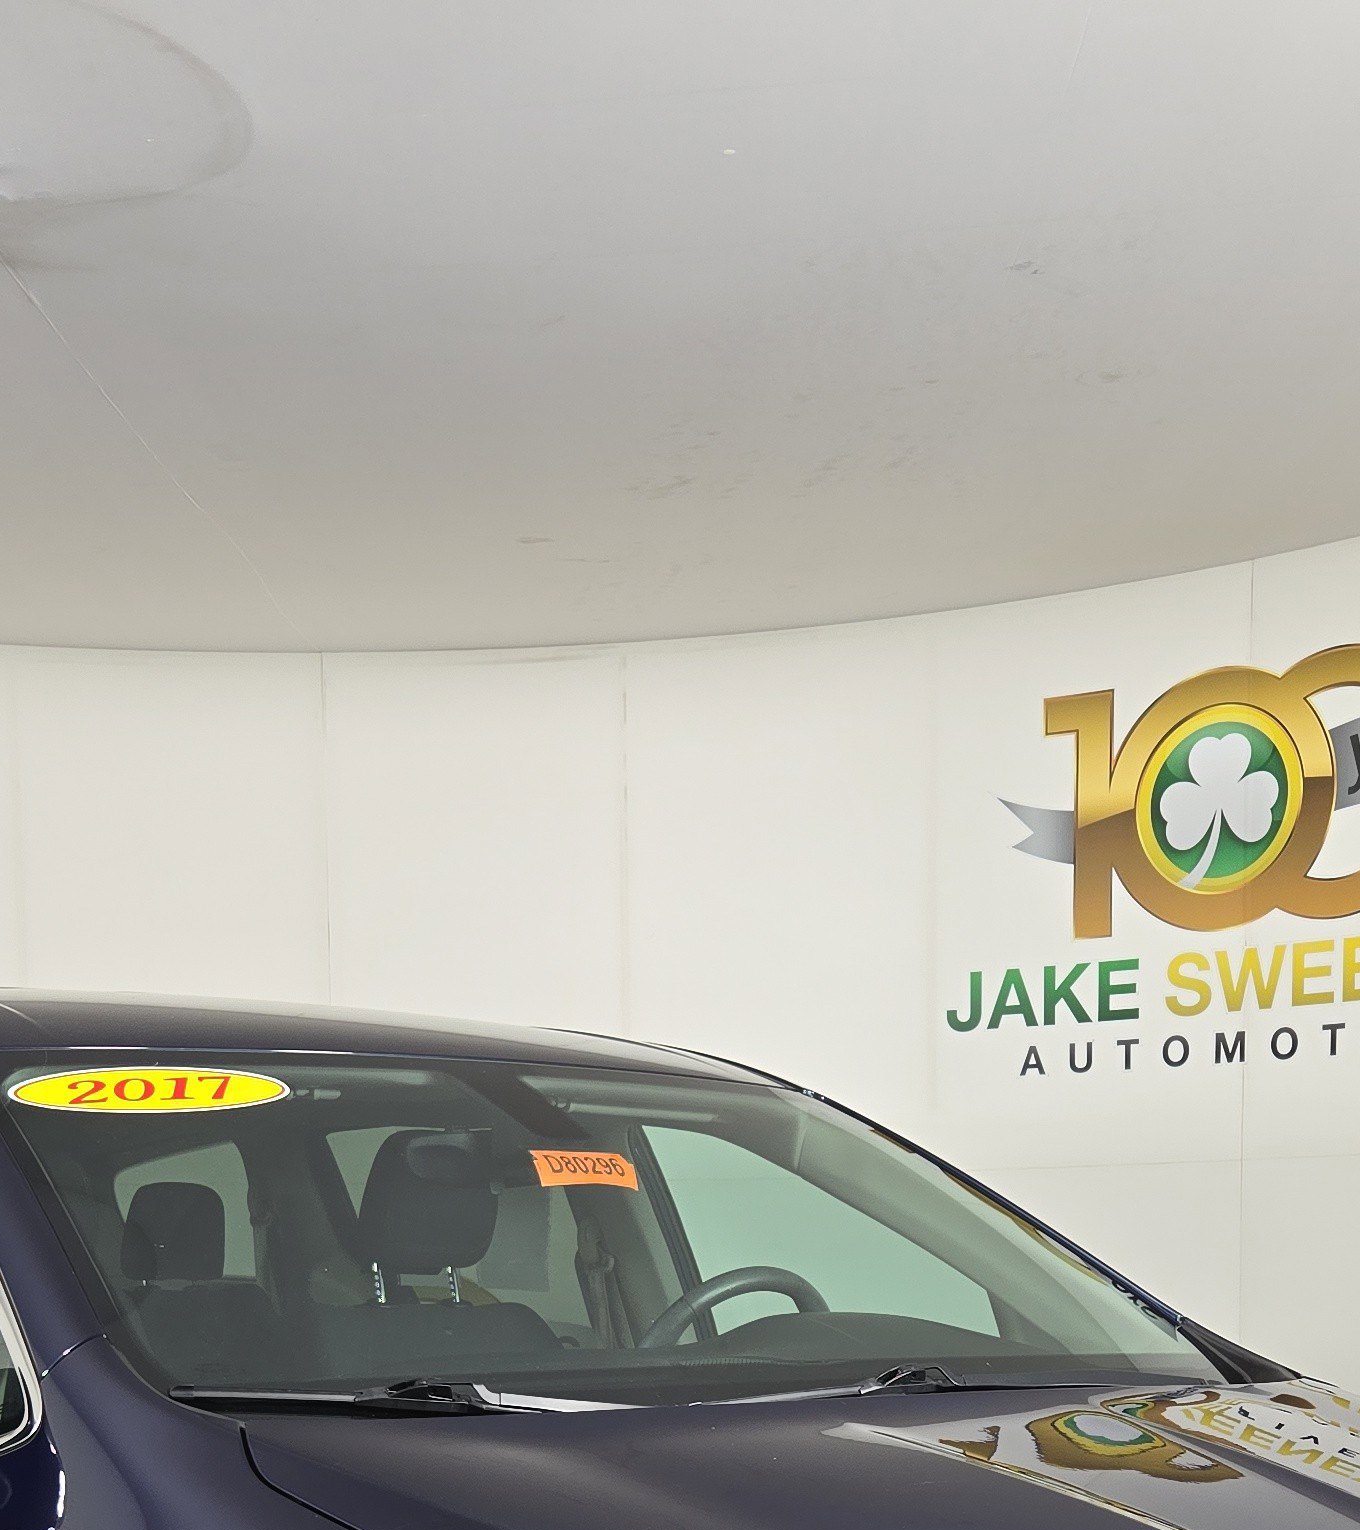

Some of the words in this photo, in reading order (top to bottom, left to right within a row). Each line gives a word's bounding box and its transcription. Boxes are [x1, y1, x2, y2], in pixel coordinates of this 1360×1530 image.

[947, 958, 1139, 1032] JAKE
[68, 1076, 231, 1104] 2017
[543, 1154, 625, 1177] D80296
